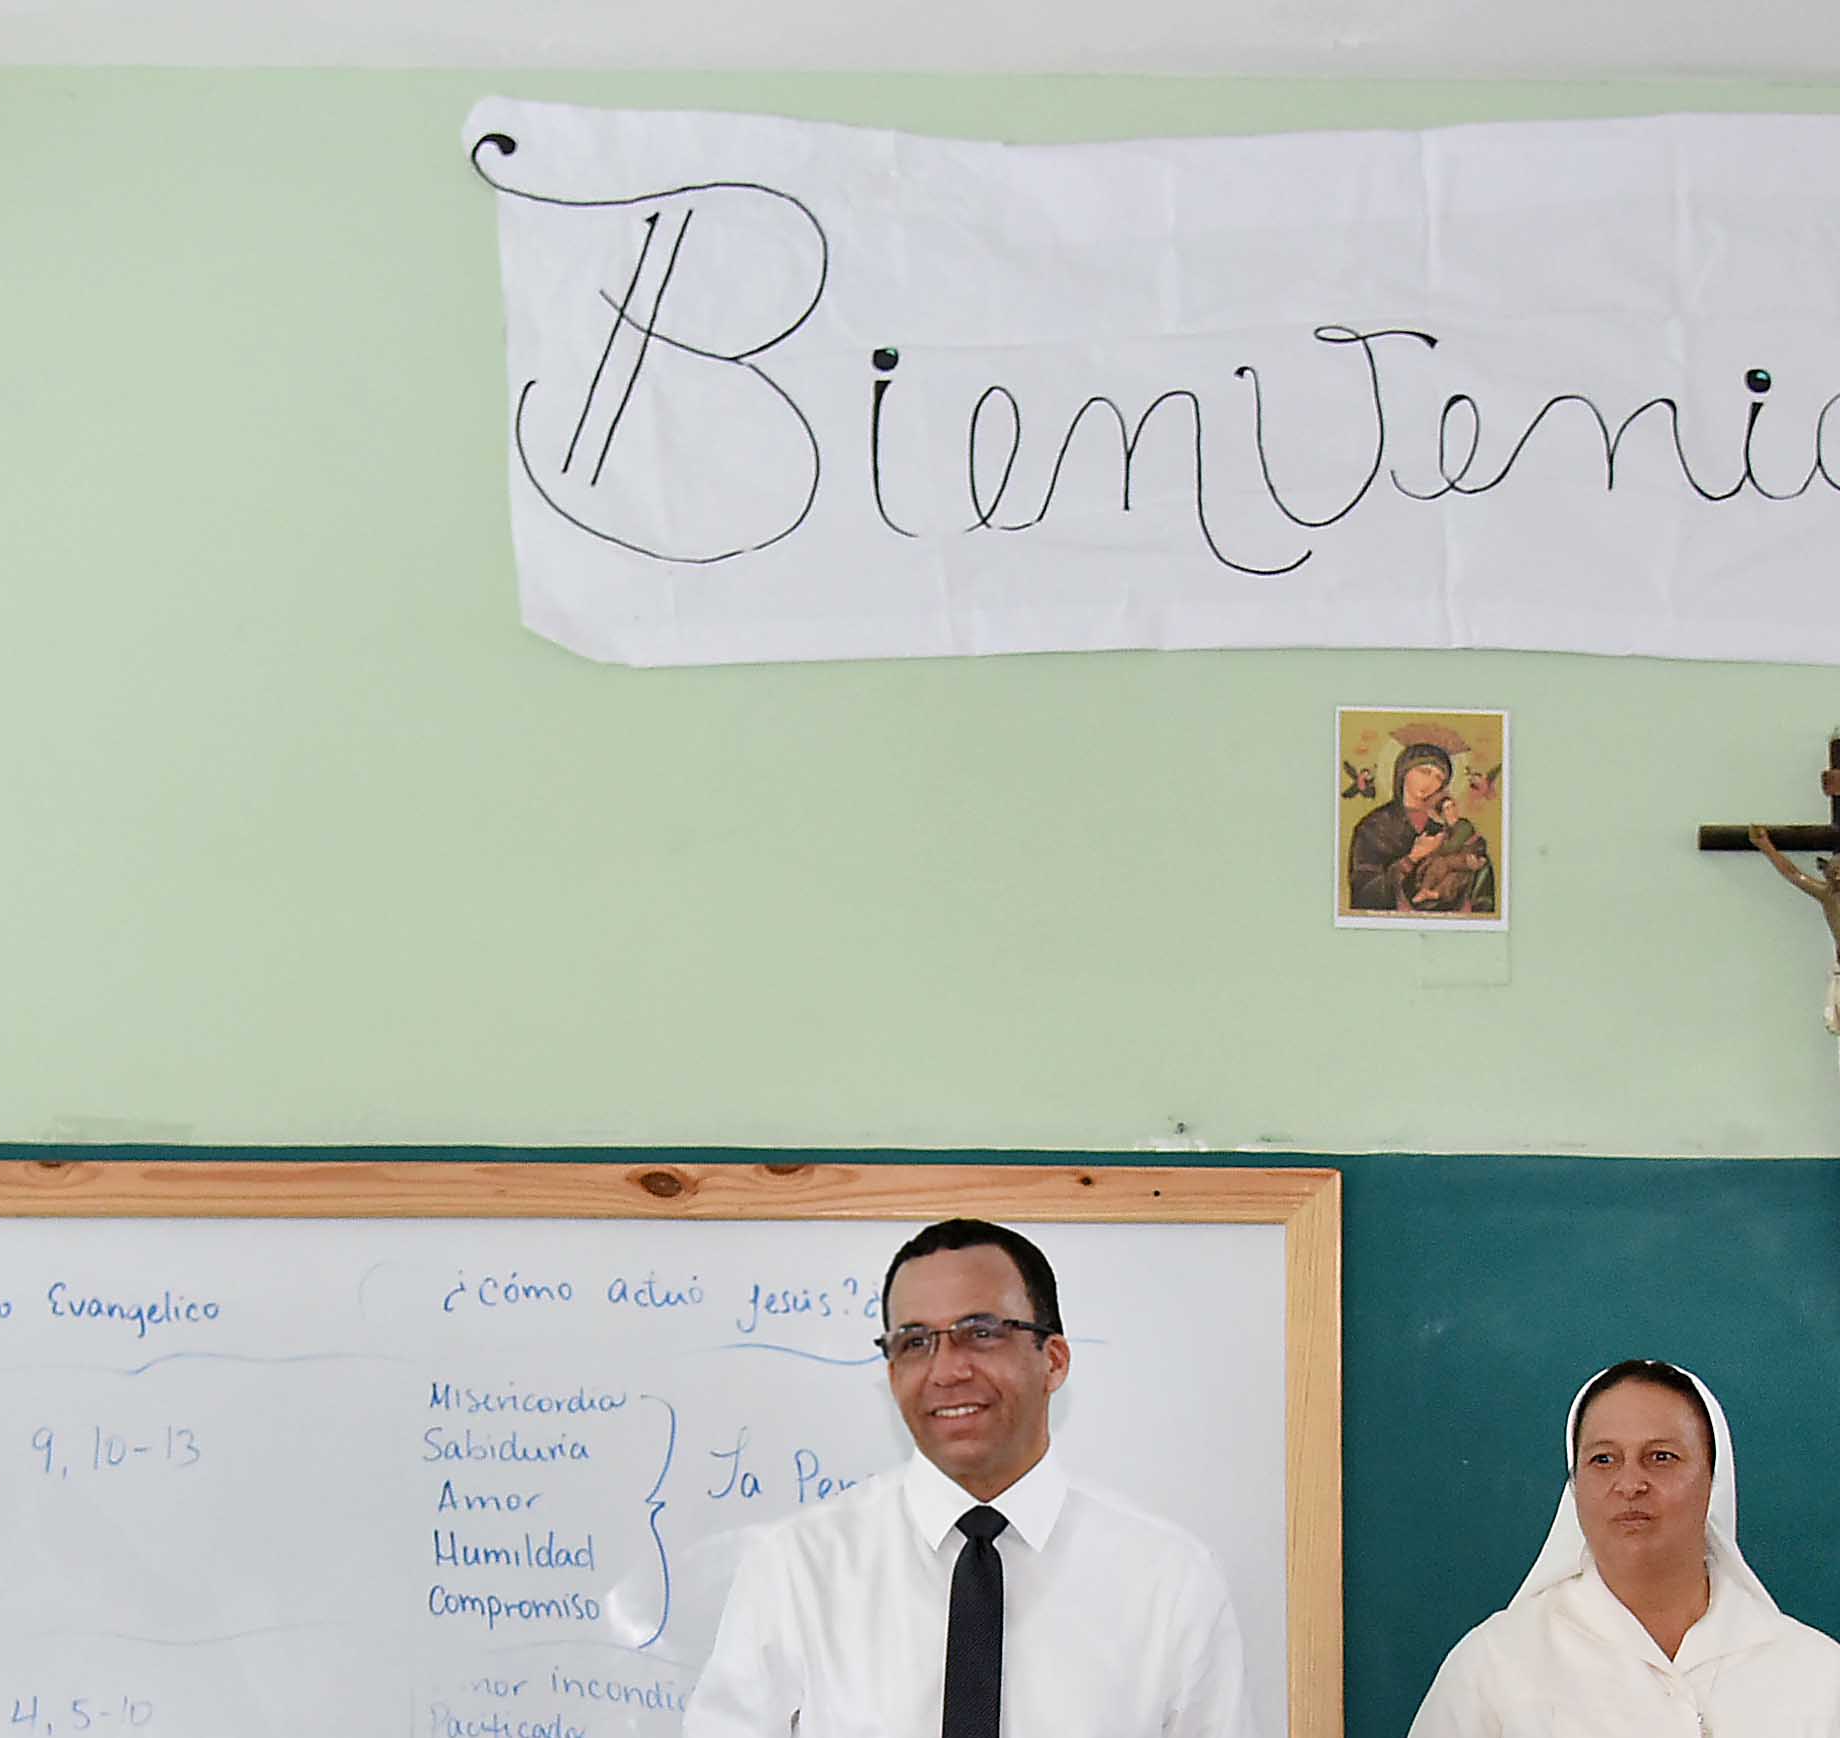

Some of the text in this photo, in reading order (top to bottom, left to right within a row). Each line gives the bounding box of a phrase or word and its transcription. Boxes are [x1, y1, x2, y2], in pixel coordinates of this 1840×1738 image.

[430, 1381, 627, 1414] Misericordia
[439, 1479, 544, 1512] Amor
[434, 1529, 594, 1571] Humildad
[428, 1584, 600, 1630] Compromiso
